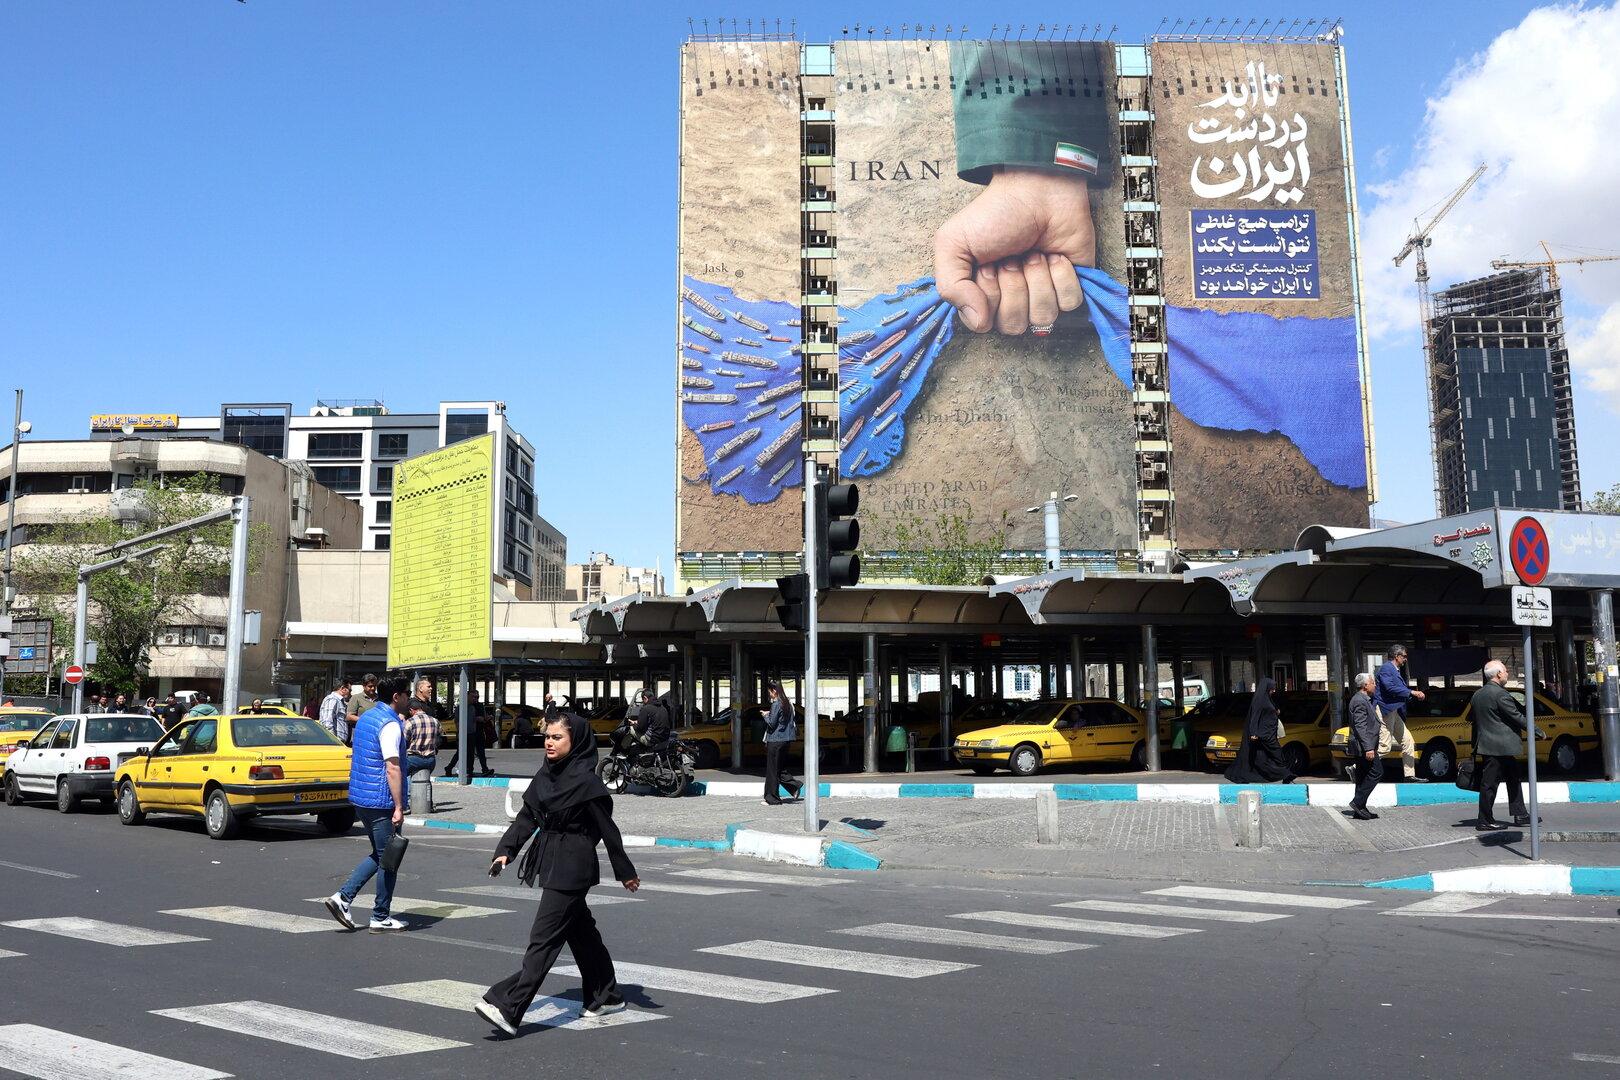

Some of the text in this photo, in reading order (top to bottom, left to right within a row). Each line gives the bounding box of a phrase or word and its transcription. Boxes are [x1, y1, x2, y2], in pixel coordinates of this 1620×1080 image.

[1192, 60, 1284, 118] تا ابد
[1187, 112, 1308, 148] در دست
[849, 160, 941, 181] IRAN
[1190, 141, 1311, 204] ایران
[1195, 213, 1309, 235] ترامپ هیچ غلطی
[1197, 235, 1311, 258] نتوانست بکند
[702, 263, 729, 275] Jask
[1199, 262, 1312, 275] کنترل همیشگی تنگه هرمز
[1199, 276, 1313, 296] با ایران خواهد بود
[867, 479, 988, 497] UNITED ARAB
[1264, 480, 1333, 497] Muscat
[882, 497, 971, 513] EMIRATES
[1463, 522, 1492, 539] مقصد
